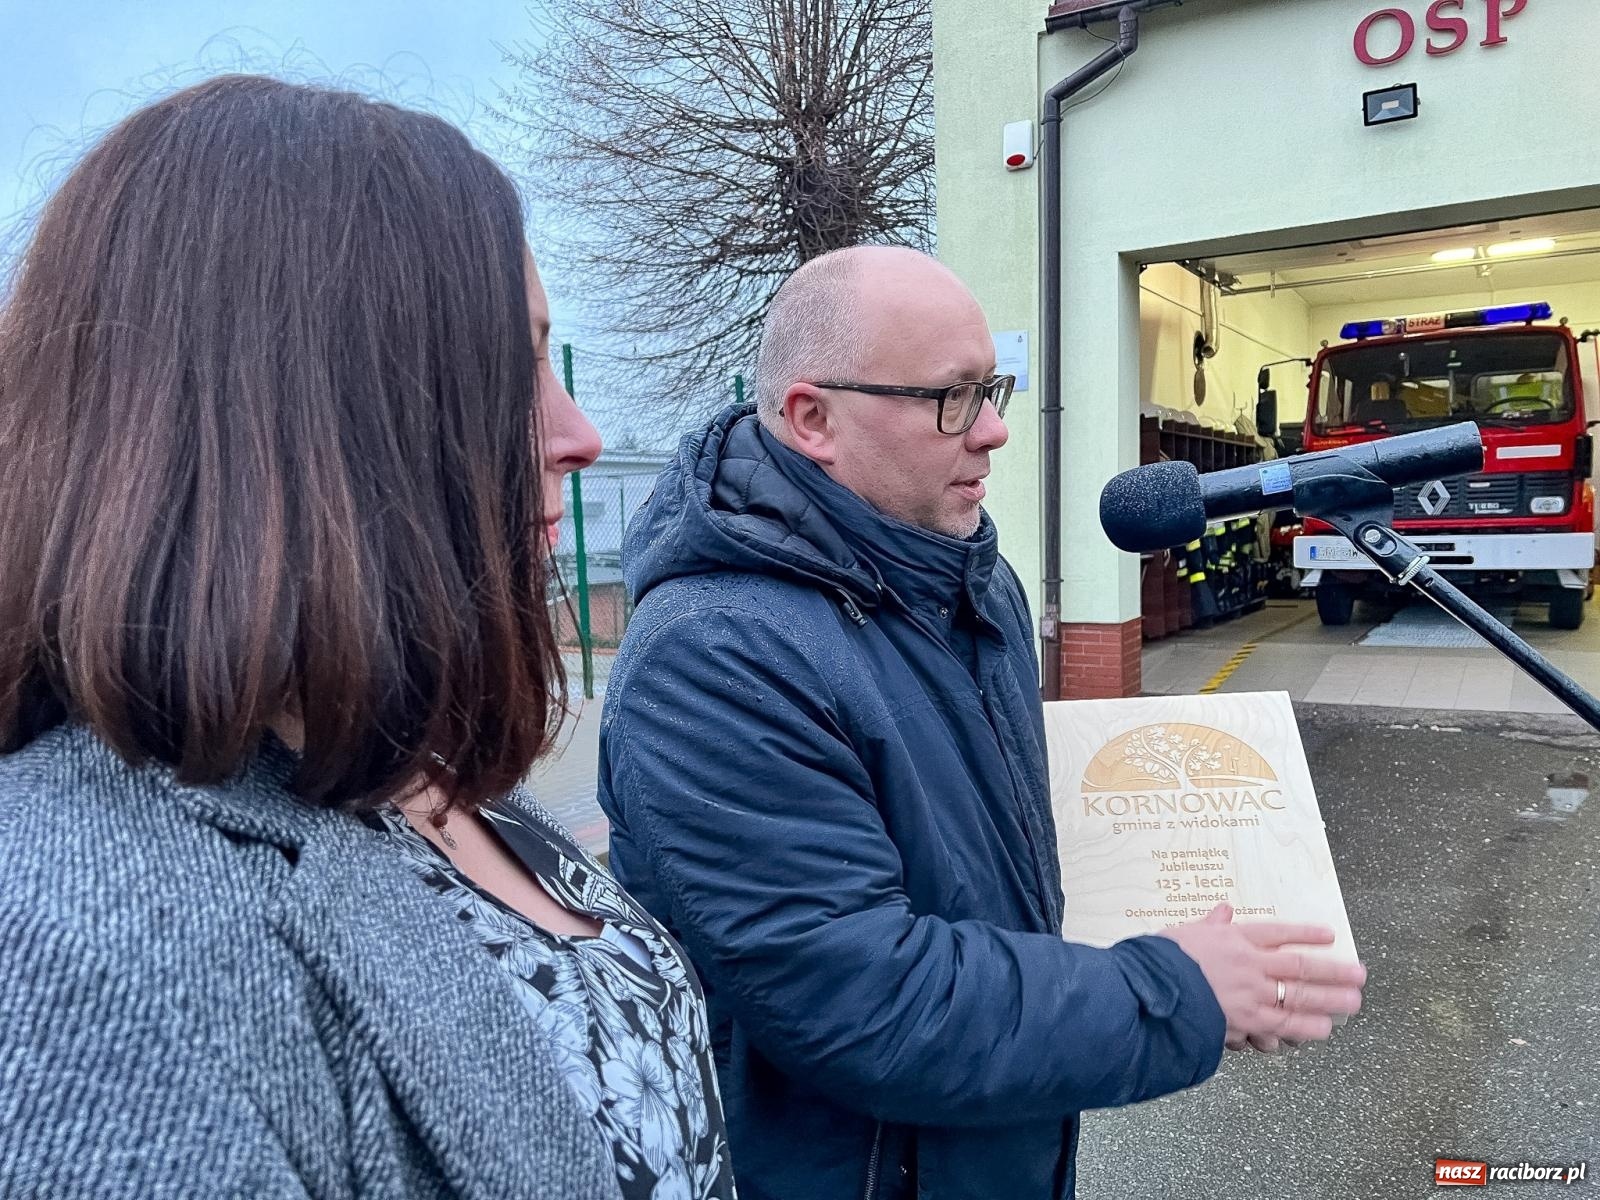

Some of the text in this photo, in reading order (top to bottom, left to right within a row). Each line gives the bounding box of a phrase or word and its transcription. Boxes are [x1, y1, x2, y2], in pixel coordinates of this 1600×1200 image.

[1353, 0, 1528, 65] OSP
[1081, 790, 1286, 817] KORNOWAC
[1112, 814, 1260, 835] gmina z widokami
[1151, 848, 1230, 860] Na pamiątkę
[1159, 862, 1225, 872] Jubileuszu
[1154, 879, 1182, 892] 125
[1194, 875, 1235, 888] lecia
[1166, 892, 1229, 903] działalności
[1125, 907, 1188, 918] Ochotniczej
[1232, 905, 1277, 917] ożarnej
